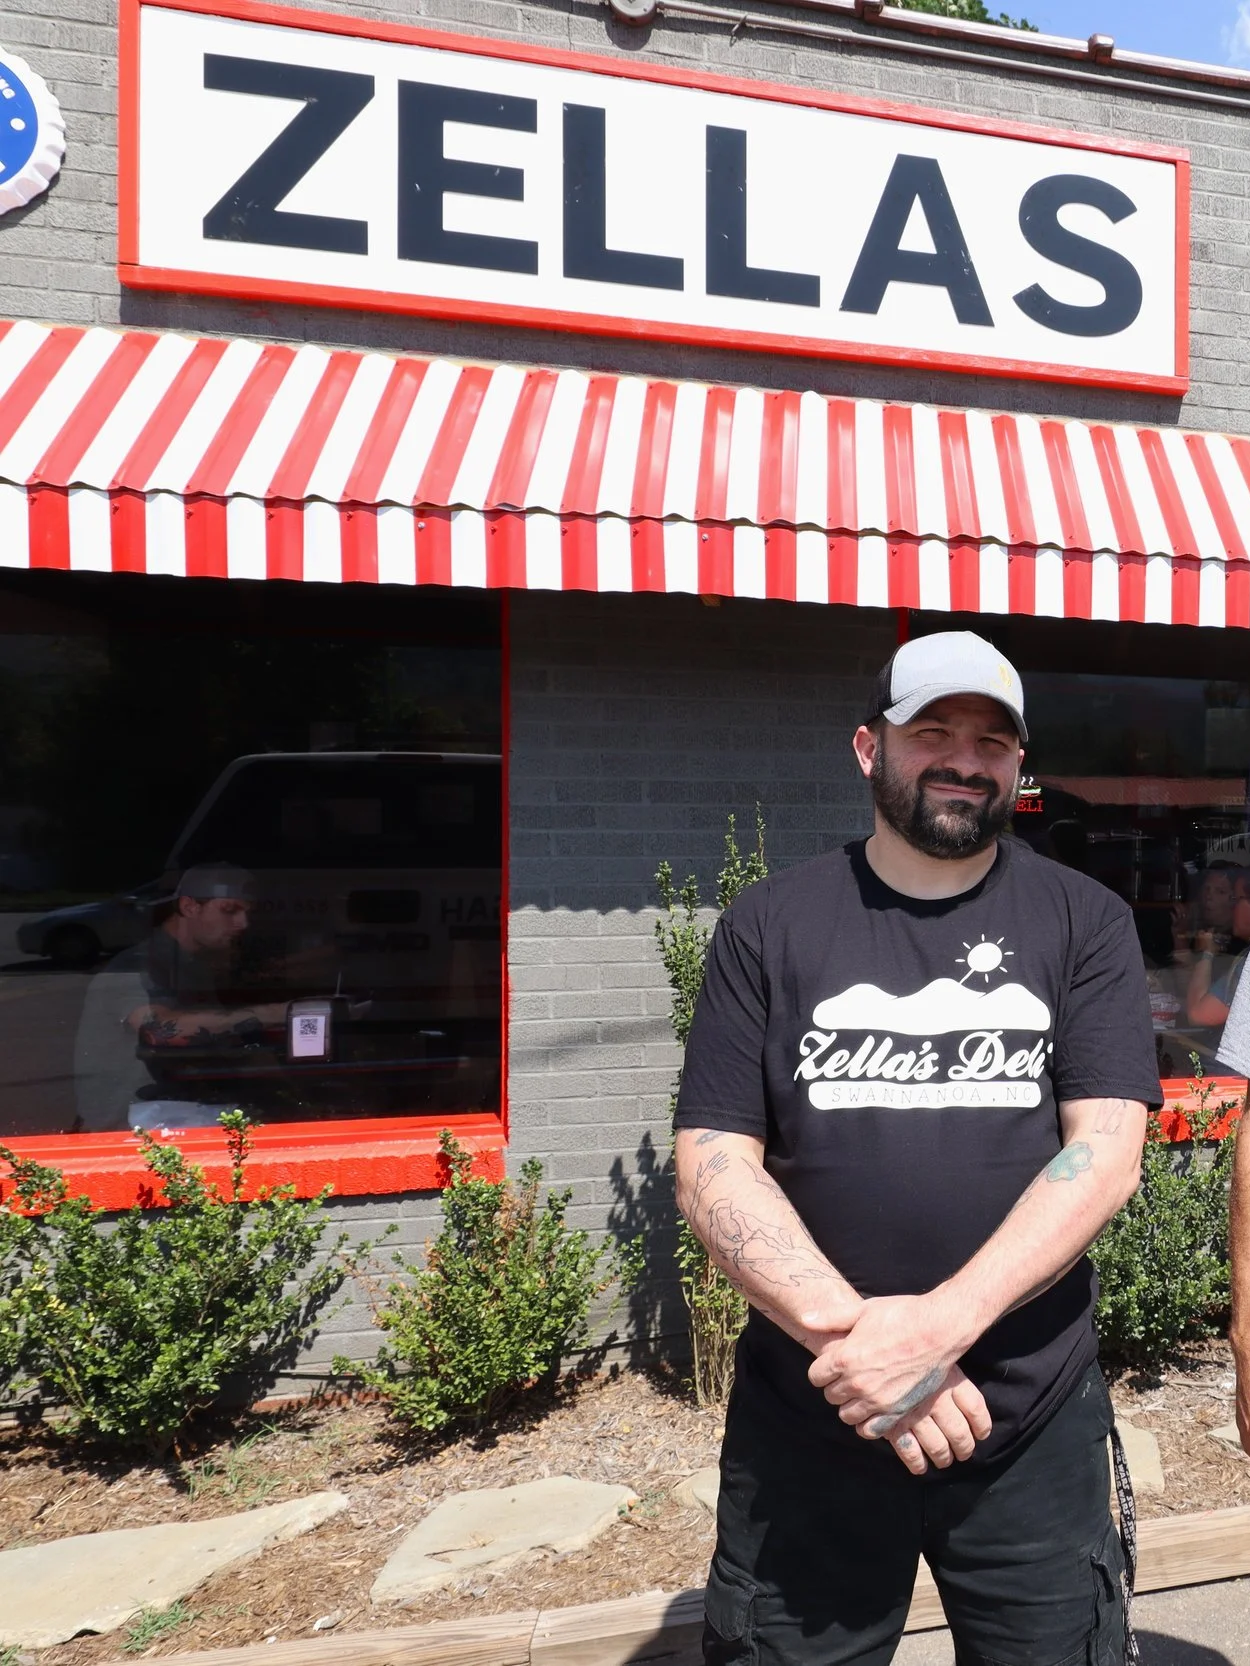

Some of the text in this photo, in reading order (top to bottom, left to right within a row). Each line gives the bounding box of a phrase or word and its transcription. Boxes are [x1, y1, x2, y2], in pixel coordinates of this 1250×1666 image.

[203, 53, 1143, 339] ZELLAS
[1015, 799, 1044, 812] ELI
[794, 1030, 1054, 1082] Zella's Deli
[1006, 1086, 1032, 1101] NC
[1118, 1463, 1131, 1490] WARS
[1118, 1489, 1131, 1516] WARS
